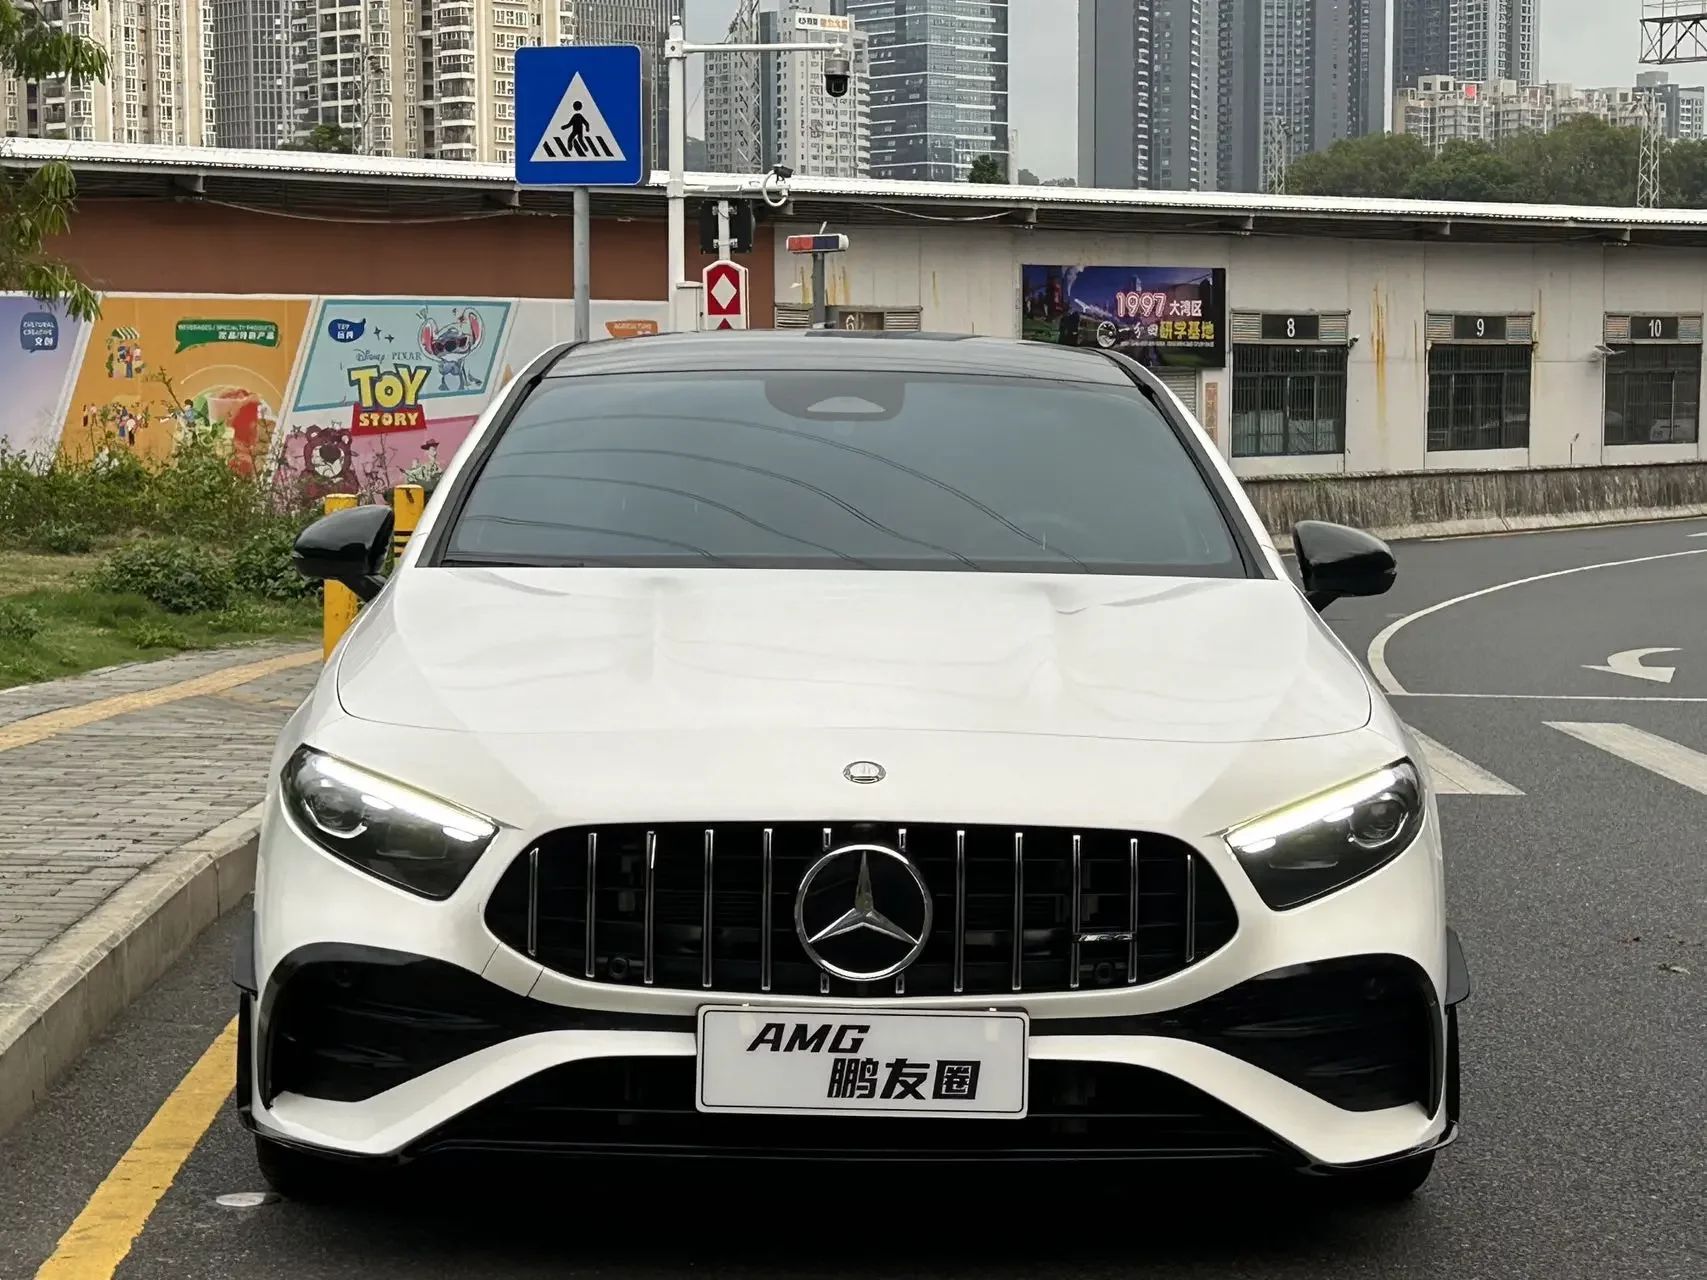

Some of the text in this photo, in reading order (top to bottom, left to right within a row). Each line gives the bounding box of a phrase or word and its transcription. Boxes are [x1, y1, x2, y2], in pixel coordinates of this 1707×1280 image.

[1115, 291, 1202, 317] 1997 大湾区
[1286, 317, 1296, 338] 8
[1475, 319, 1486, 338] 9
[1649, 319, 1663, 338] 10
[354, 348, 422, 364] Disney PIXAR
[347, 363, 432, 411] TOY
[359, 412, 419, 427] STORY
[746, 1023, 871, 1053] AMG
[827, 1057, 980, 1101] 鹏友圈
